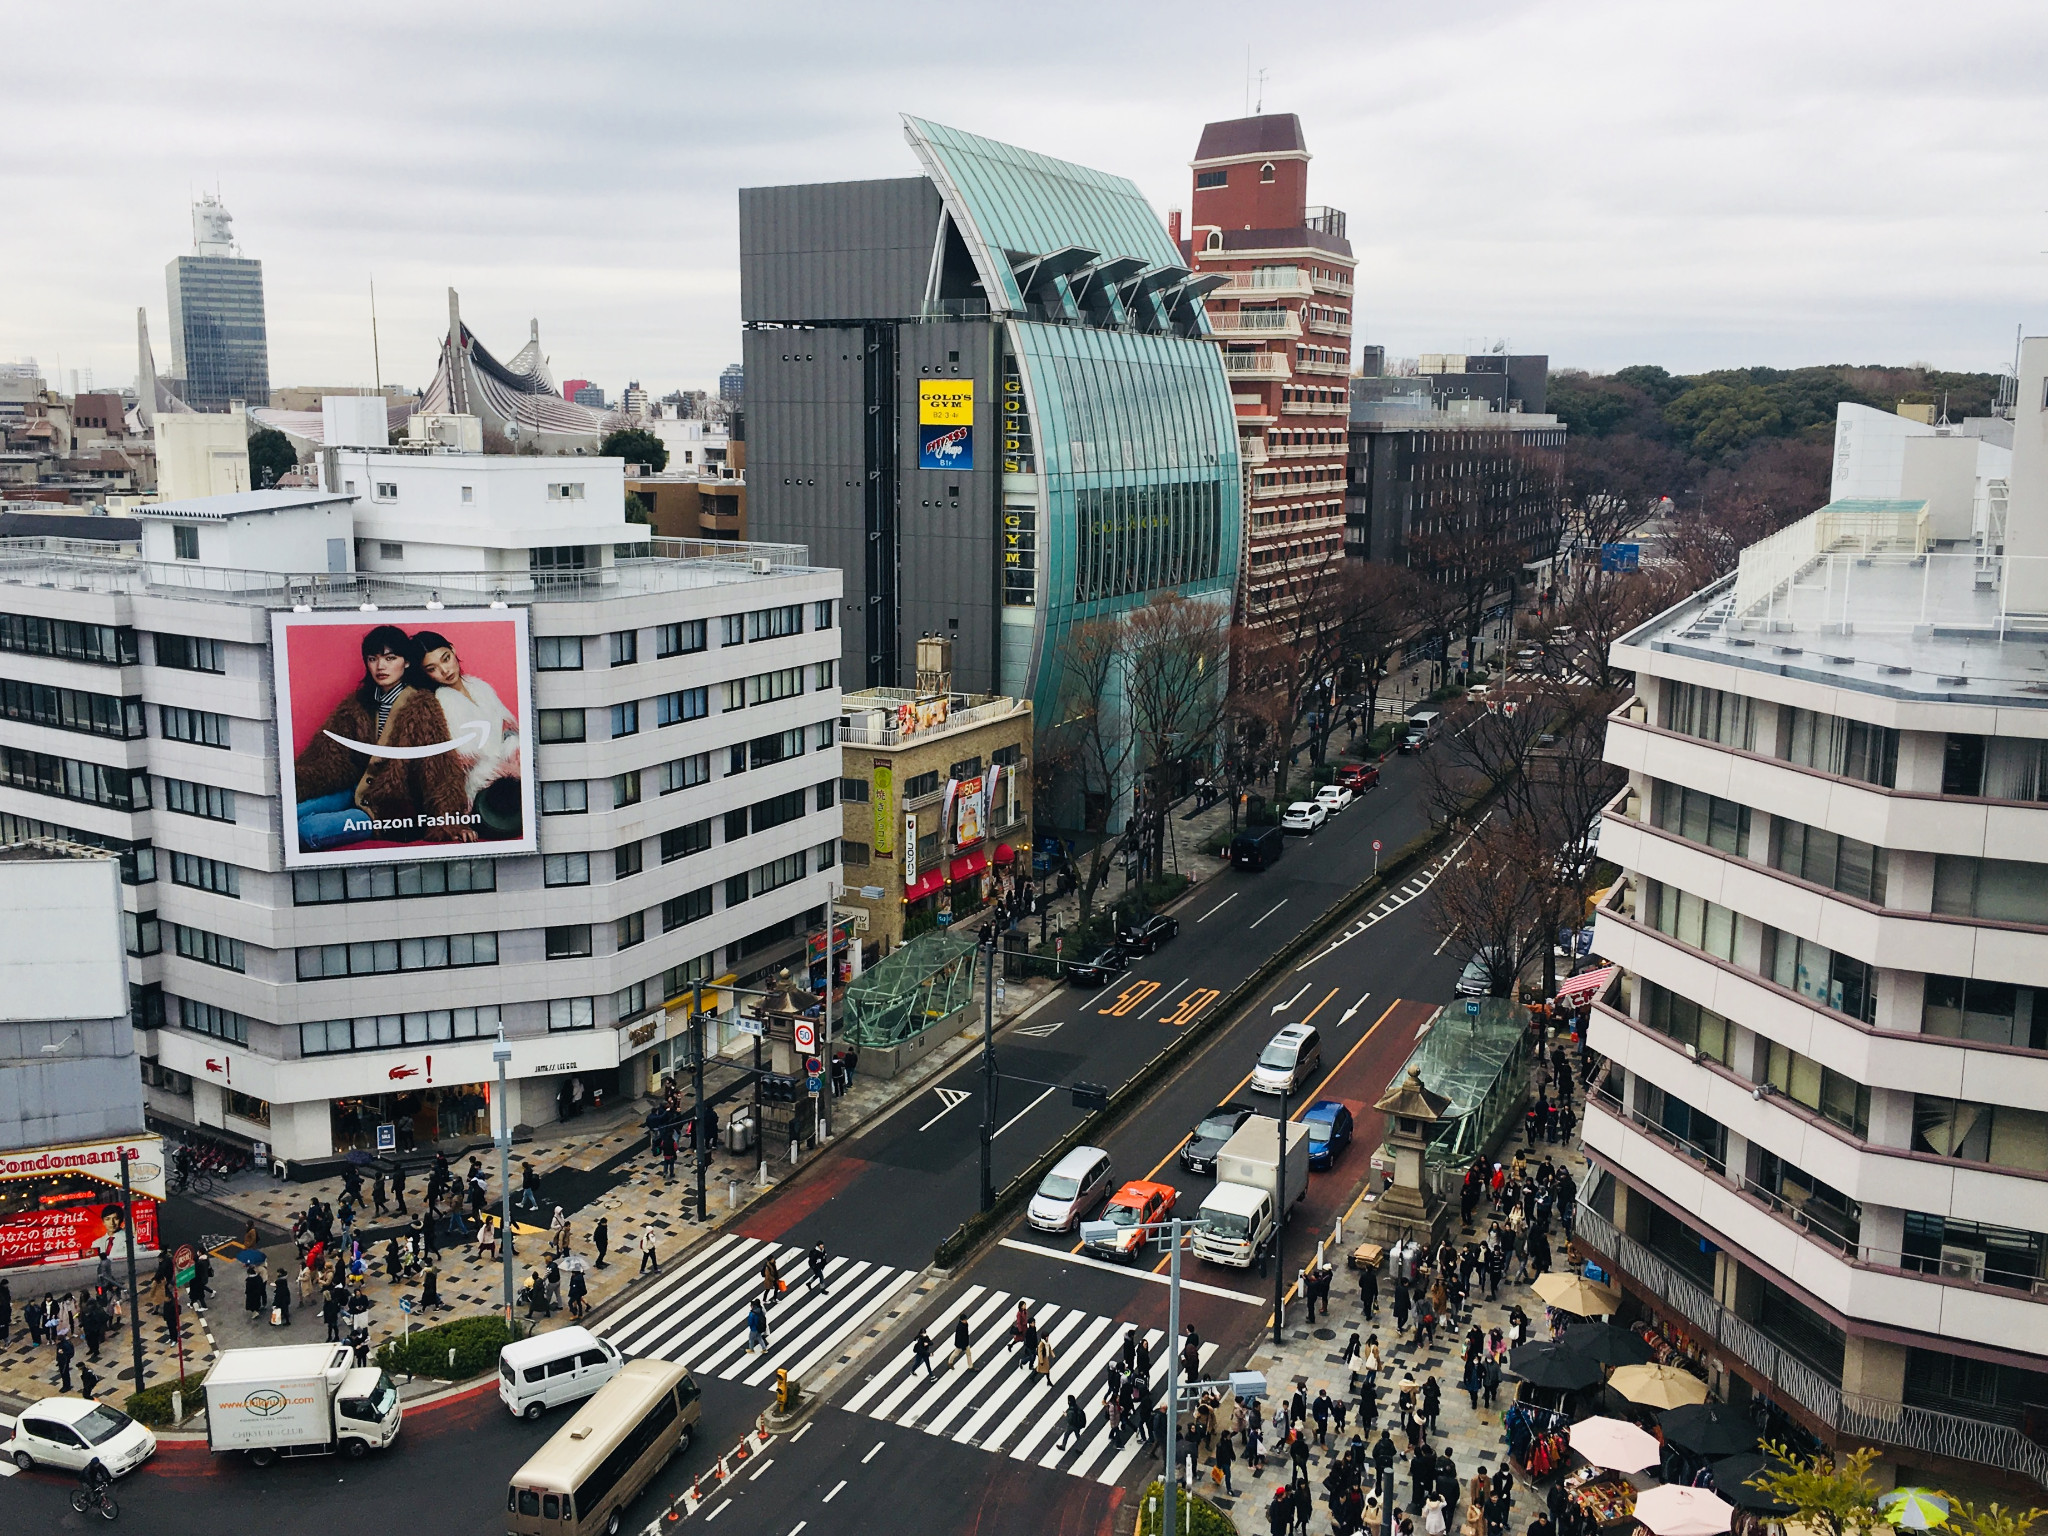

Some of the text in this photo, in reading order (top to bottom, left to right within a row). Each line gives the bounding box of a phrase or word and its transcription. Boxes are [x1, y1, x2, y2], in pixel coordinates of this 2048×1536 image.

[921, 393, 972, 401] GOLD'S
[926, 426, 968, 455] FITNESS
[1004, 381, 1021, 473] GOLD'S
[940, 459, 952, 467] B1F
[1005, 515, 1021, 563] GYM
[343, 811, 481, 832] Amazon Fashion
[876, 789, 886, 849] 焼きショコラ
[907, 842, 915, 877] コロンバン
[1097, 980, 1162, 1017] 50
[1158, 987, 1220, 1026] 50
[799, 1030, 810, 1041] 50
